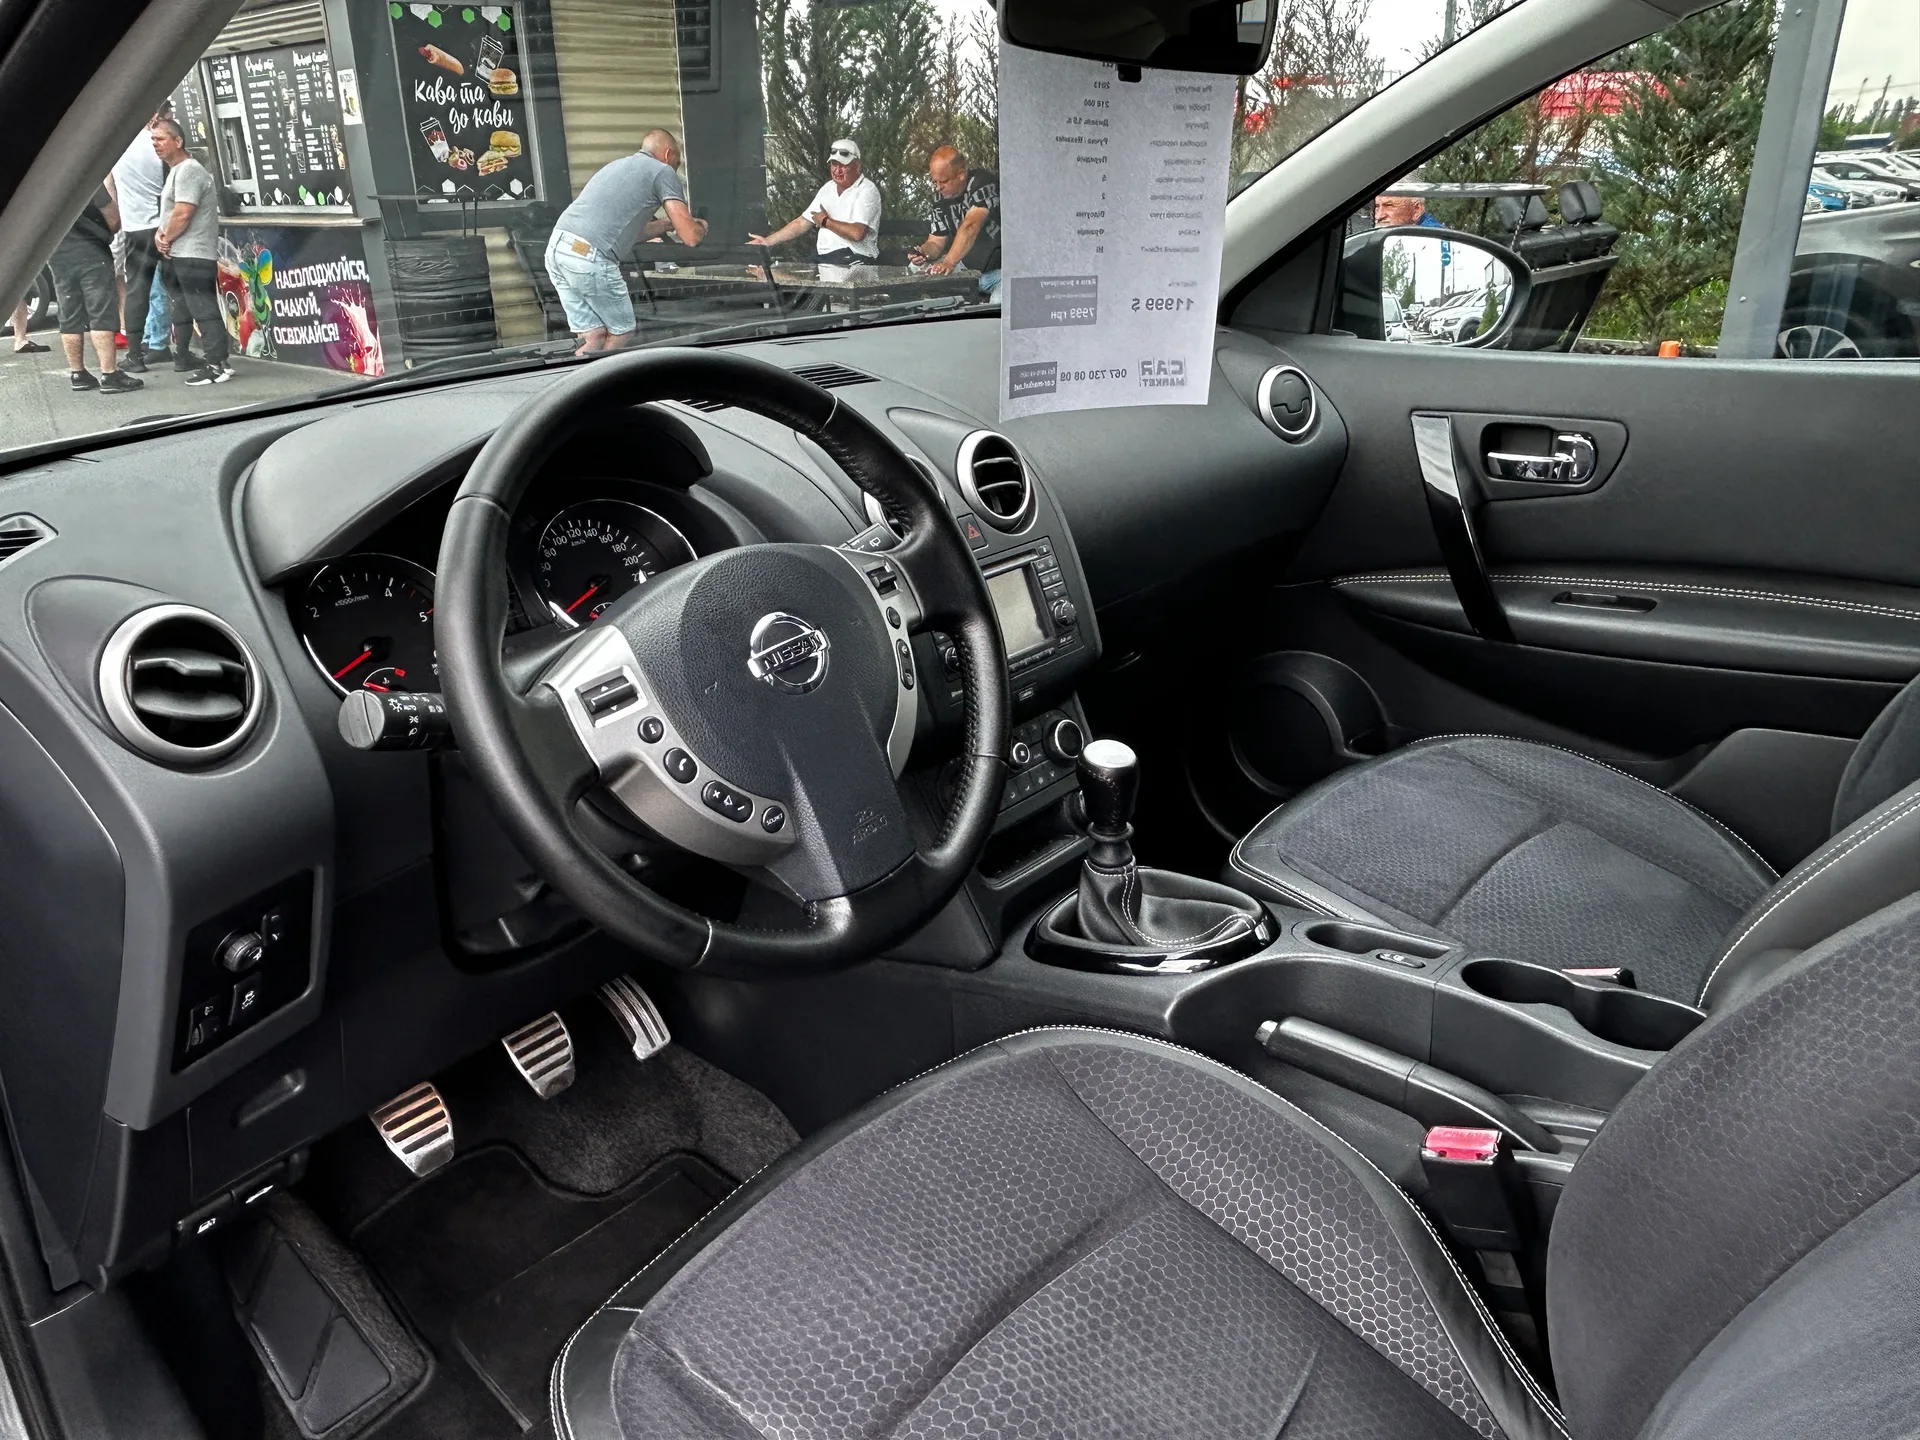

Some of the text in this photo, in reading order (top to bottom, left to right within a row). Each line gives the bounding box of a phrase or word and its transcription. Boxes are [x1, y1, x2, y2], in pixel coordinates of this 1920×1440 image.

[415, 75, 457, 106] Кава
[449, 100, 514, 134] до кави
[274, 255, 370, 289] НАСОЛОДЖУЙСЯ,
[274, 291, 322, 317] СМАКУЙ,
[566, 528, 582, 538] 120
[584, 528, 598, 538] 140
[598, 533, 614, 544] 160
[552, 535, 568, 546] 100
[544, 547, 557, 558] 80
[612, 542, 627, 553] 180
[622, 555, 638, 566] 200
[342, 585, 352, 596] 3
[384, 588, 393, 598] 4
[310, 606, 320, 618] 2
[419, 611, 428, 622] 5
